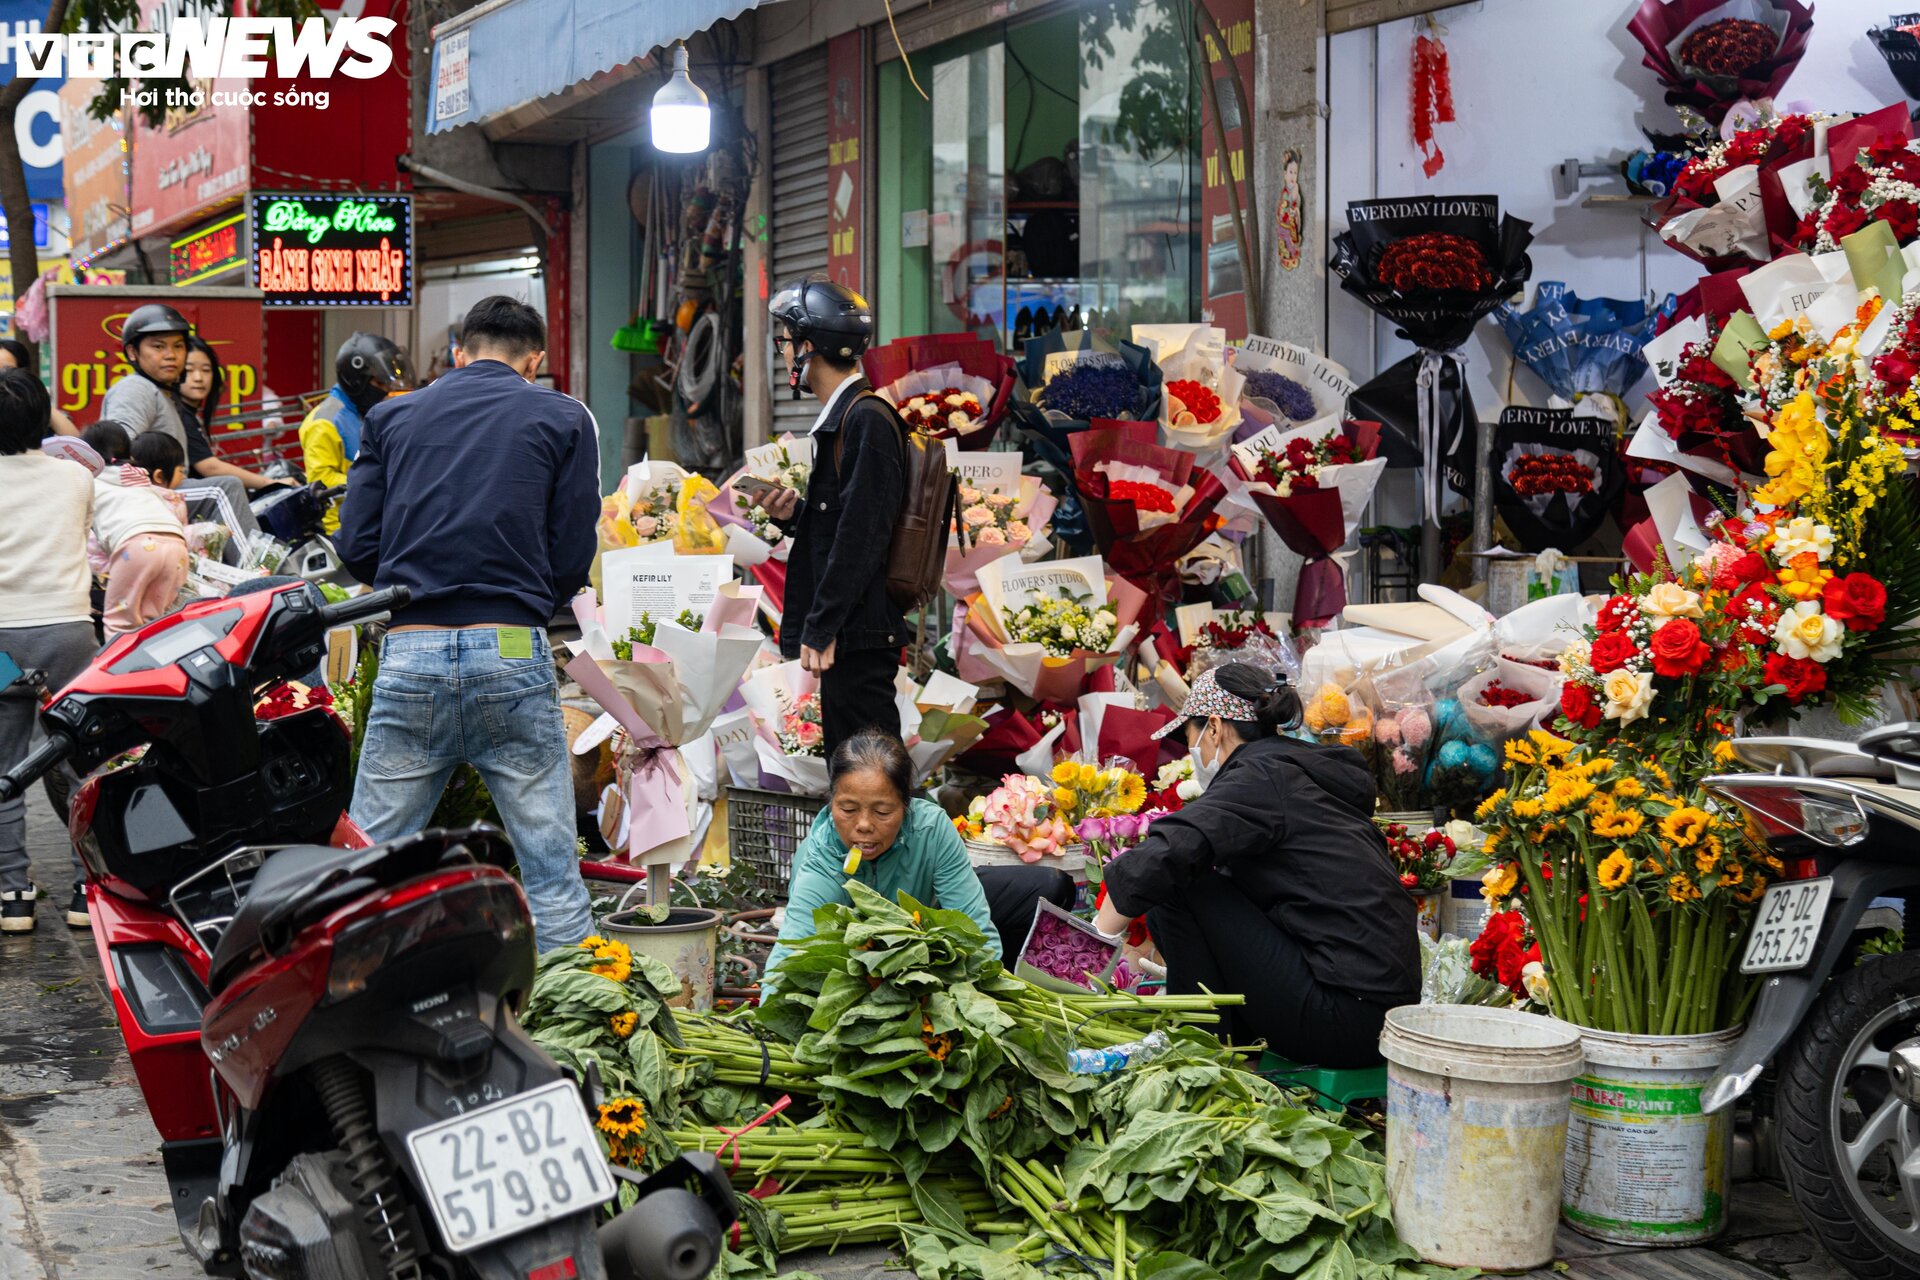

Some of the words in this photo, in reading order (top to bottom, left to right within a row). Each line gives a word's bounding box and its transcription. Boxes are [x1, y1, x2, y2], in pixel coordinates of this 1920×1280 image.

[1351, 201, 1431, 222] EVERYDAY
[1441, 201, 1482, 218] LOVE
[260, 237, 309, 292] BÁNH
[311, 249, 353, 292] SINH
[355, 237, 404, 301] NHẬT
[1246, 338, 1308, 366] EVERYDAY
[1549, 420, 1591, 435] LOVE
[656, 574, 672, 583] LILY
[1002, 574, 1045, 592] FLOWERS
[1047, 572, 1083, 586] STUDIO
[1765, 885, 1819, 925] 29-D2
[1746, 925, 1814, 966] 255.25
[1626, 1100, 1674, 1112] PAINT
[440, 1101, 566, 1181] 22-B2
[443, 1147, 599, 1239] 579.81
